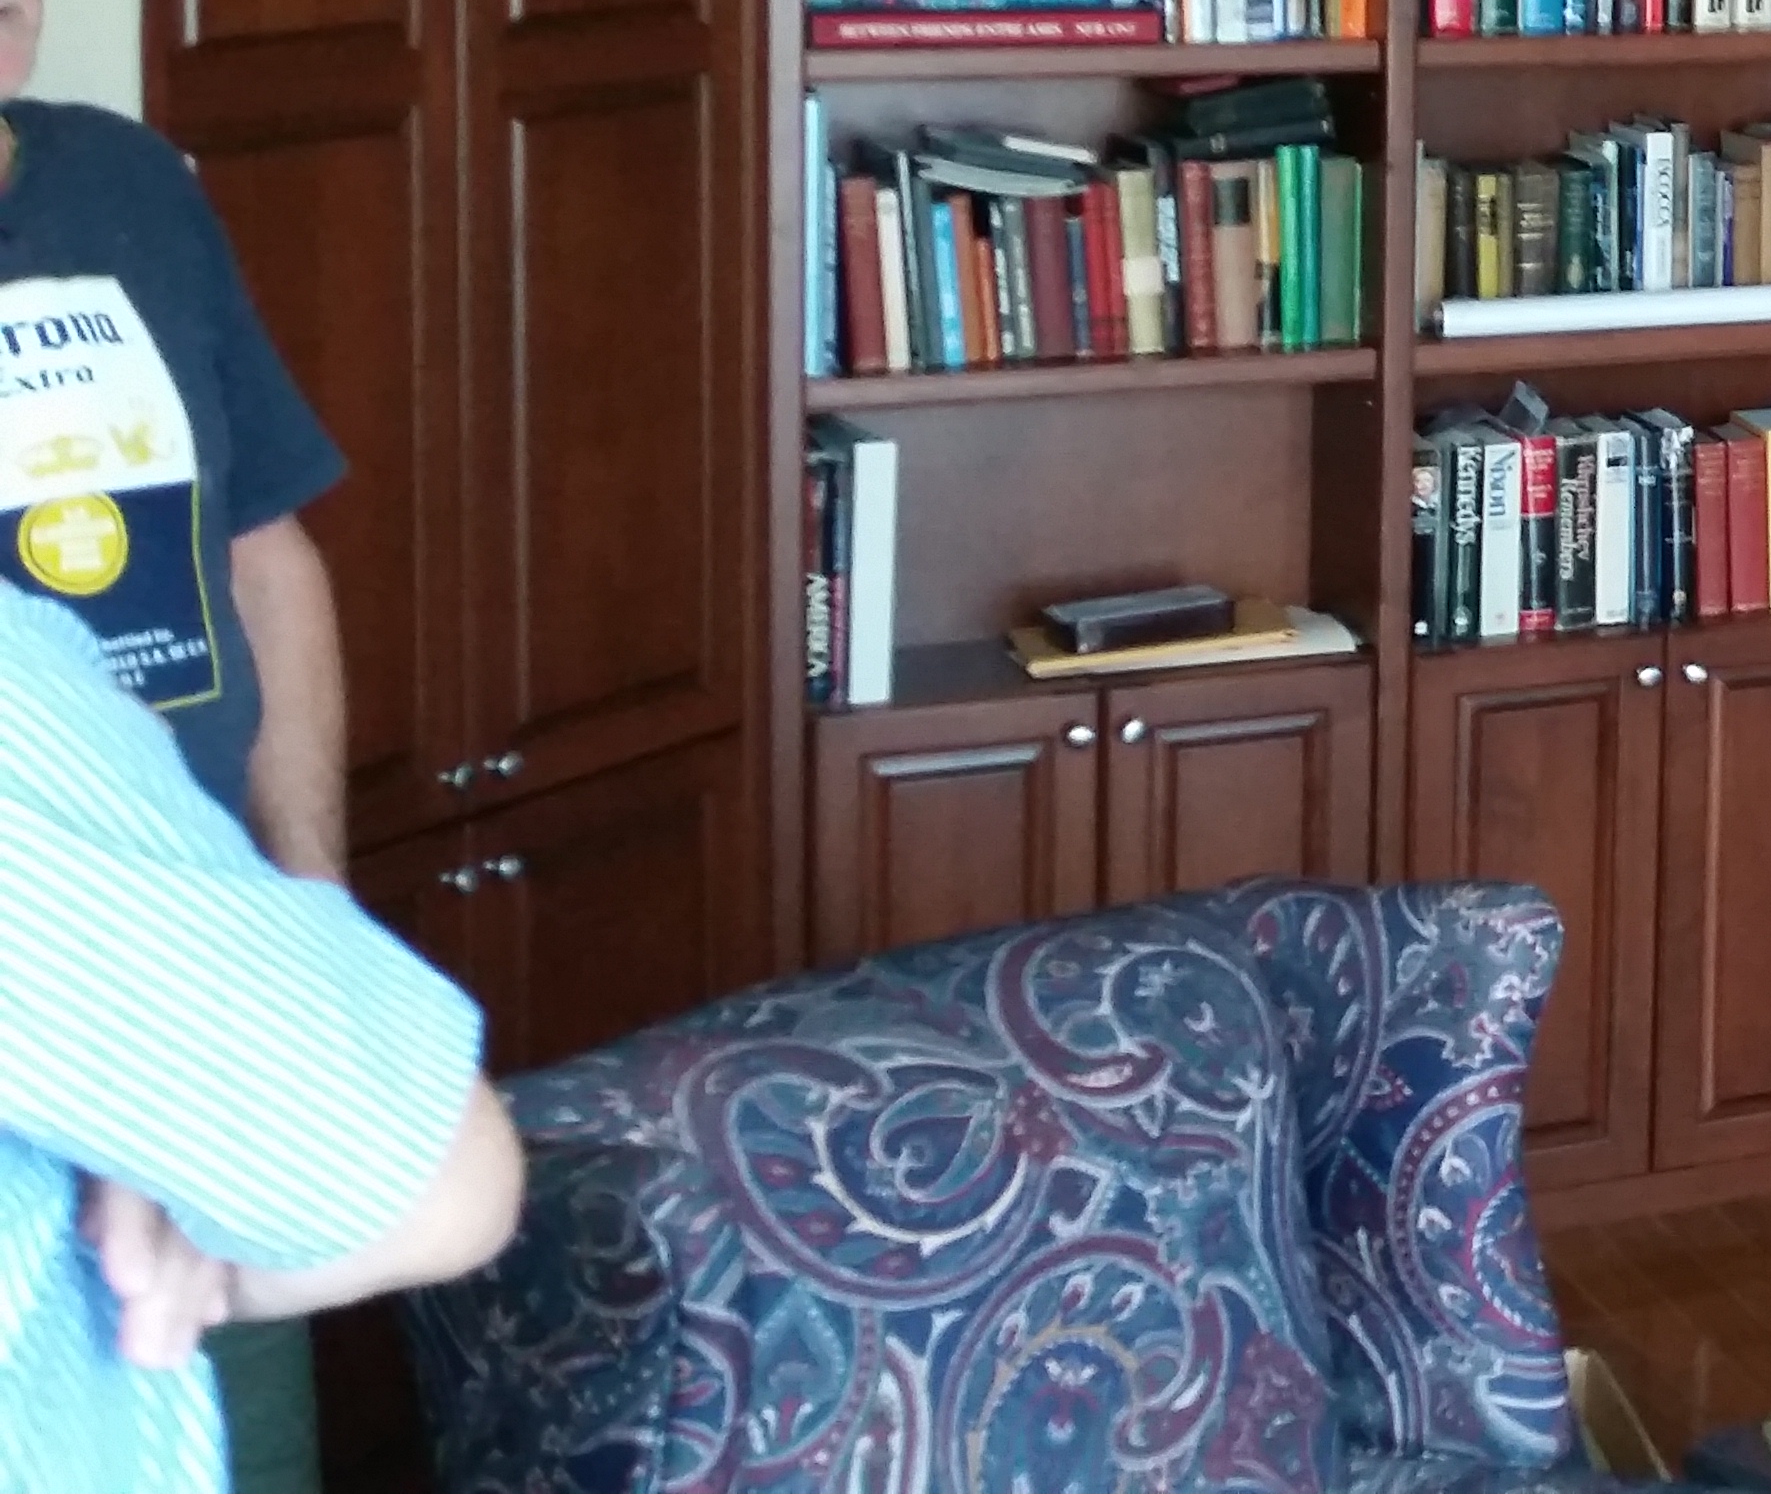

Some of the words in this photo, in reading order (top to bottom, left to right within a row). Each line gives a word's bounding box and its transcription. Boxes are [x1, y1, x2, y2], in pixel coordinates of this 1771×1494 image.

[0, 311, 124, 358] rona
[1451, 446, 1483, 547] Kennedys
[1488, 450, 1517, 519] Nixon
[1558, 477, 1581, 583] Remembers
